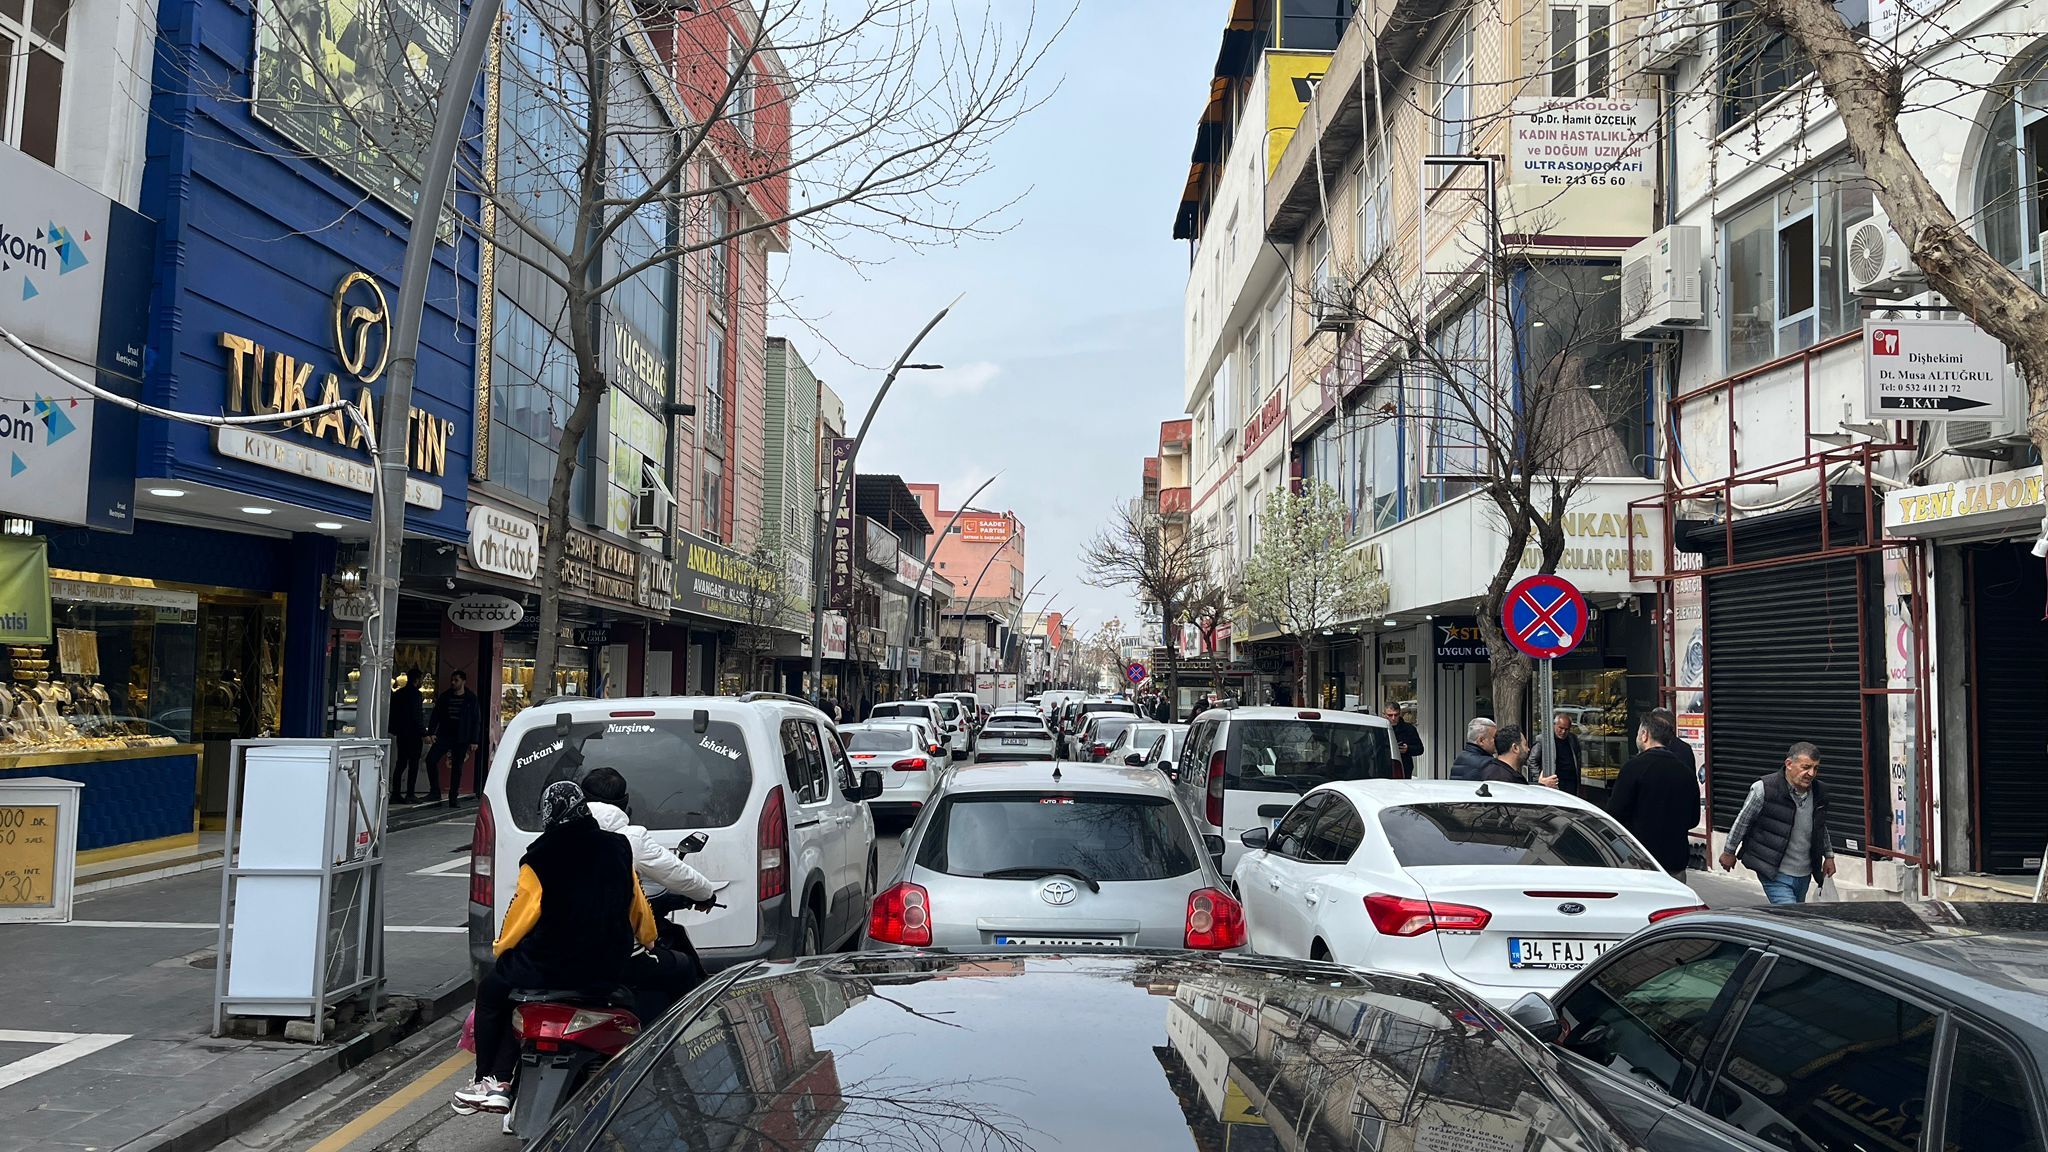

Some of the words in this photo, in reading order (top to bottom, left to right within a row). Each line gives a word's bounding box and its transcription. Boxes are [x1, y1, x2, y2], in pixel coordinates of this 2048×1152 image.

[1530, 114, 1559, 126] Op.Dr.
[1562, 114, 1591, 125] Hamit
[1594, 113, 1637, 127] ÖZÇELİK
[1519, 129, 1557, 140] KADIN
[1560, 130, 1649, 143] HASTALIKLARI
[1527, 147, 1541, 156] ve
[1544, 143, 1588, 157] DOĞUM
[1594, 146, 1641, 158] UZMANI
[1524, 160, 1643, 172] ULTRASONOGRAFİ
[1541, 175, 1562, 185] Tel:
[1565, 175, 1587, 185] 213
[1591, 176, 1606, 186] 65
[1610, 176, 1626, 186] 60
[1908, 352, 1963, 365] Dişhekimi
[1880, 369, 1895, 380] Dt.
[1898, 370, 1926, 380] Musa
[1928, 369, 1993, 382] ALTUĞRUL
[1880, 383, 1896, 392] Tel:
[1898, 383, 1904, 392] 0
[1905, 384, 1920, 392] 532
[1922, 384, 1936, 392] 411
[1939, 384, 1949, 393] 21
[1951, 384, 1961, 393] 72
[218, 331, 448, 478] TUKAATIN
[1899, 398, 1909, 408] 2.
[1912, 398, 1940, 409] KAT
[1899, 482, 1956, 524] YENİ
[1958, 474, 2043, 516] JAPON
[687, 543, 721, 580] ANKARA
[1437, 647, 1473, 657] UYGUN
[1474, 646, 1492, 657] GİY
[606, 723, 643, 735] Nurşin
[698, 735, 730, 757] İshak
[515, 746, 553, 768] Furkan
[1562, 903, 1581, 913] Ford
[1522, 942, 1543, 961] 34
[1552, 942, 1585, 962] FAJ
